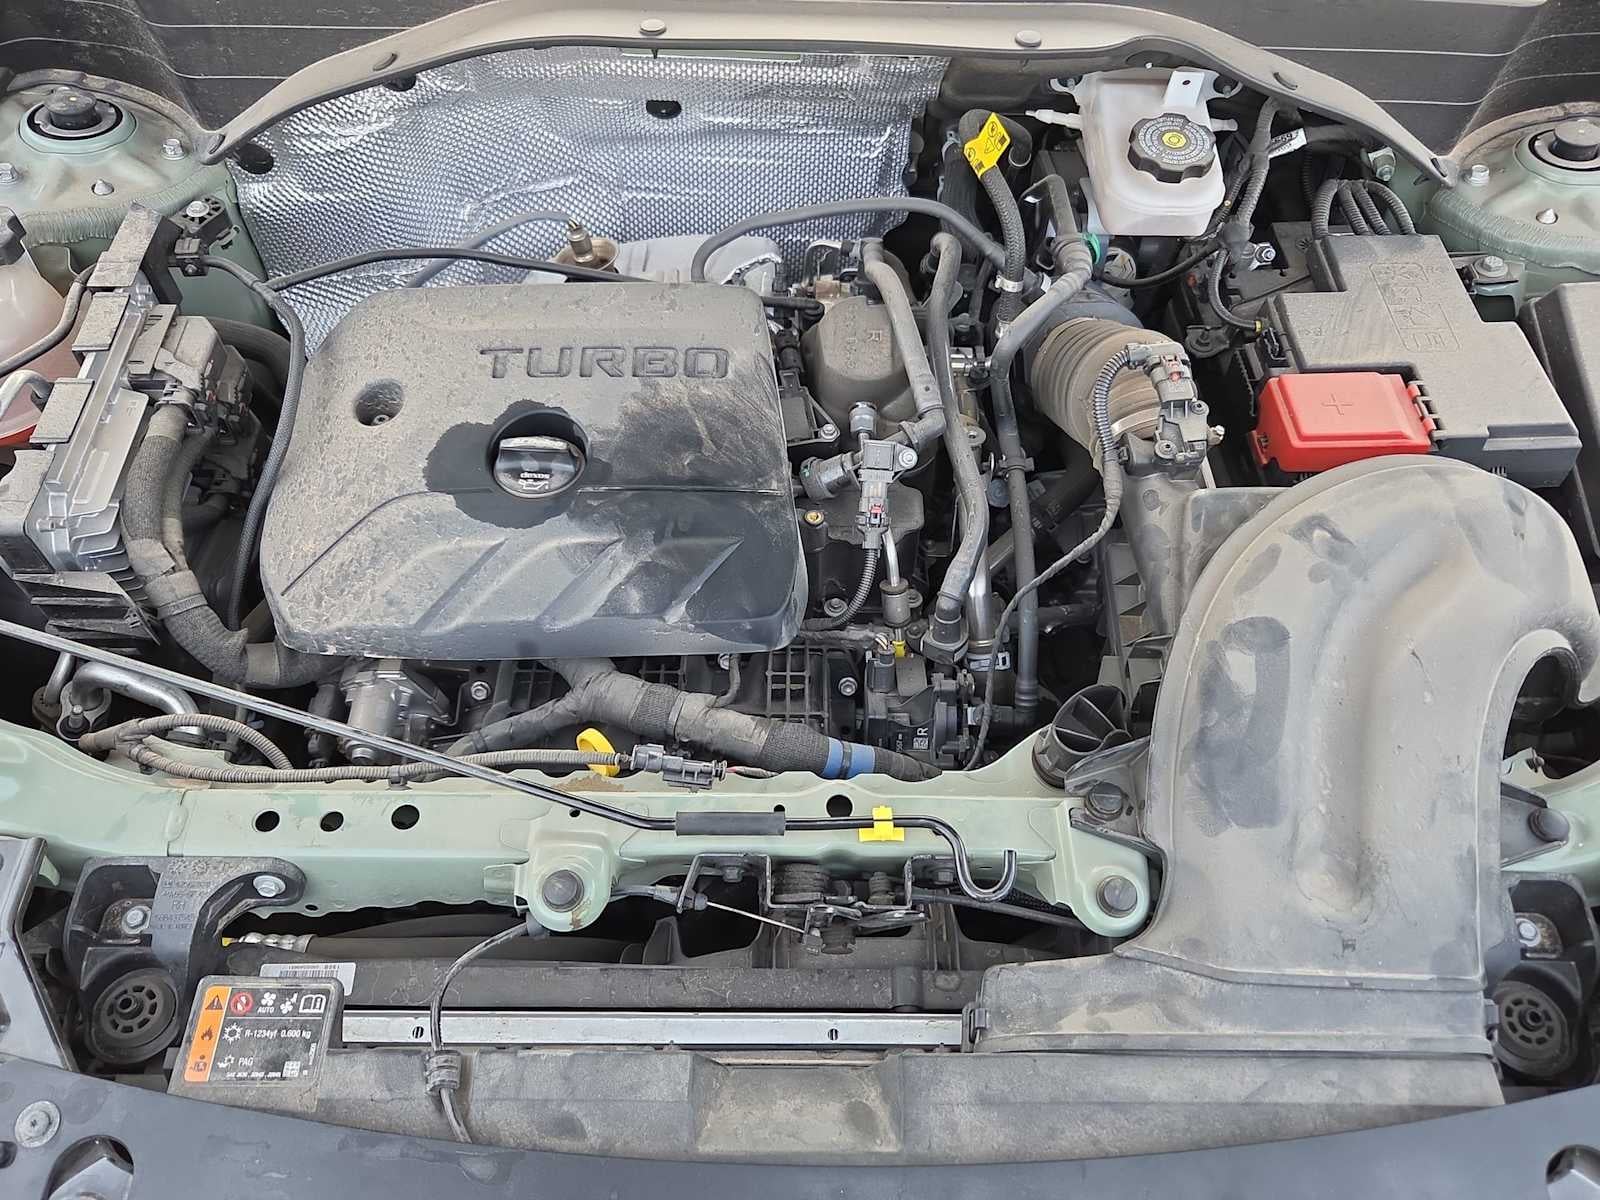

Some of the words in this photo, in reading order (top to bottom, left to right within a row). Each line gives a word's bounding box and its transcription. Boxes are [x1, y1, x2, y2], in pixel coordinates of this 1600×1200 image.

[479, 346, 729, 379] TURBO
[916, 727, 929, 736] R
[257, 1006, 275, 1014] AUTO
[244, 1029, 278, 1040] R-1234yf
[280, 1029, 301, 1038] 0.600
[301, 1029, 312, 1040] kg
[238, 1056, 254, 1067] PAG
